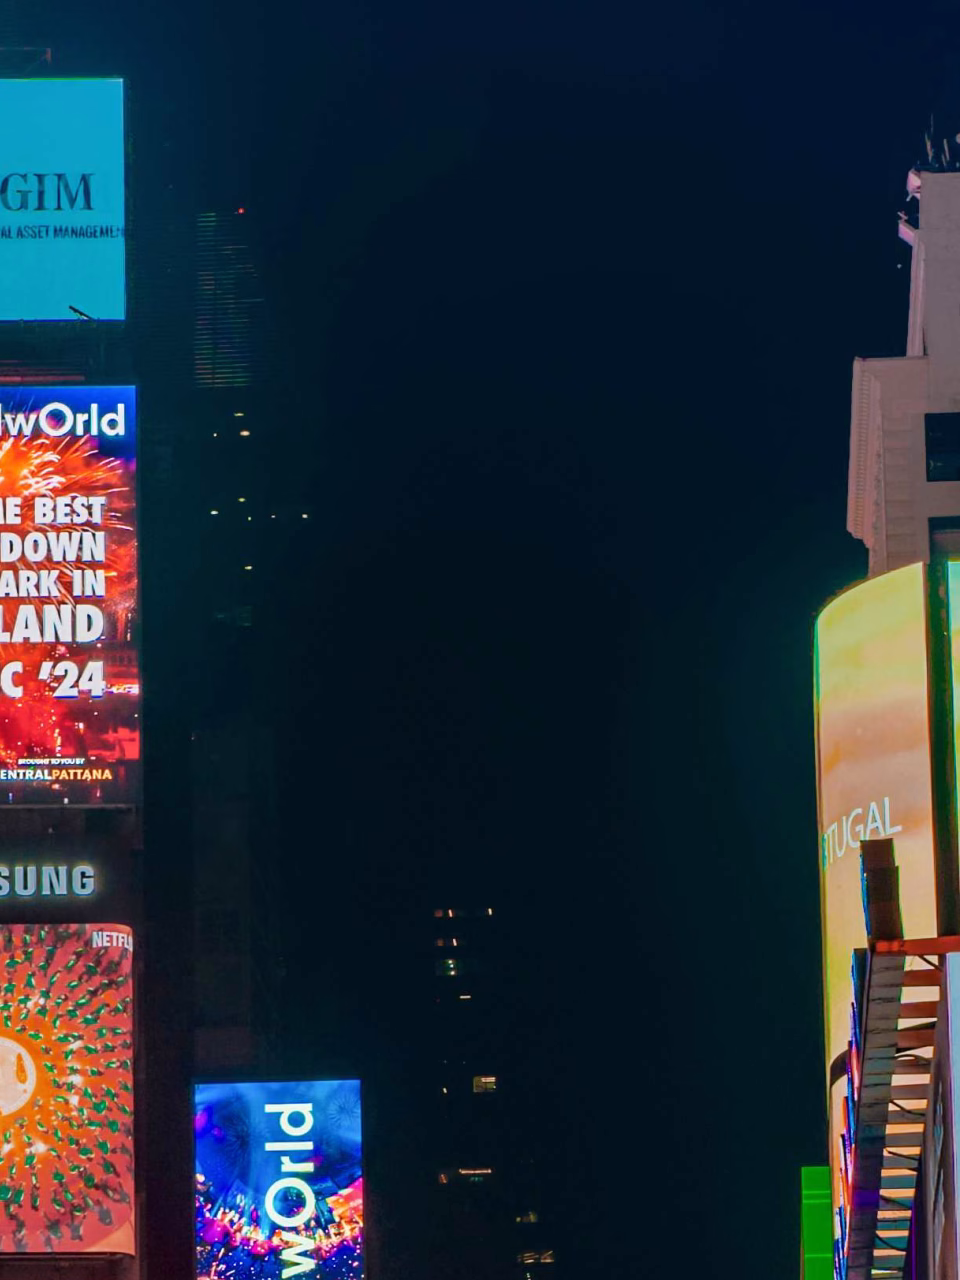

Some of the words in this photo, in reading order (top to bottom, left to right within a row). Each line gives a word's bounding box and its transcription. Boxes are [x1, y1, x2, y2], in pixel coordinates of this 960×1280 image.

[16, 225, 50, 240] ASSET
[34, 496, 105, 524] BEST
[73, 570, 105, 597] IN
